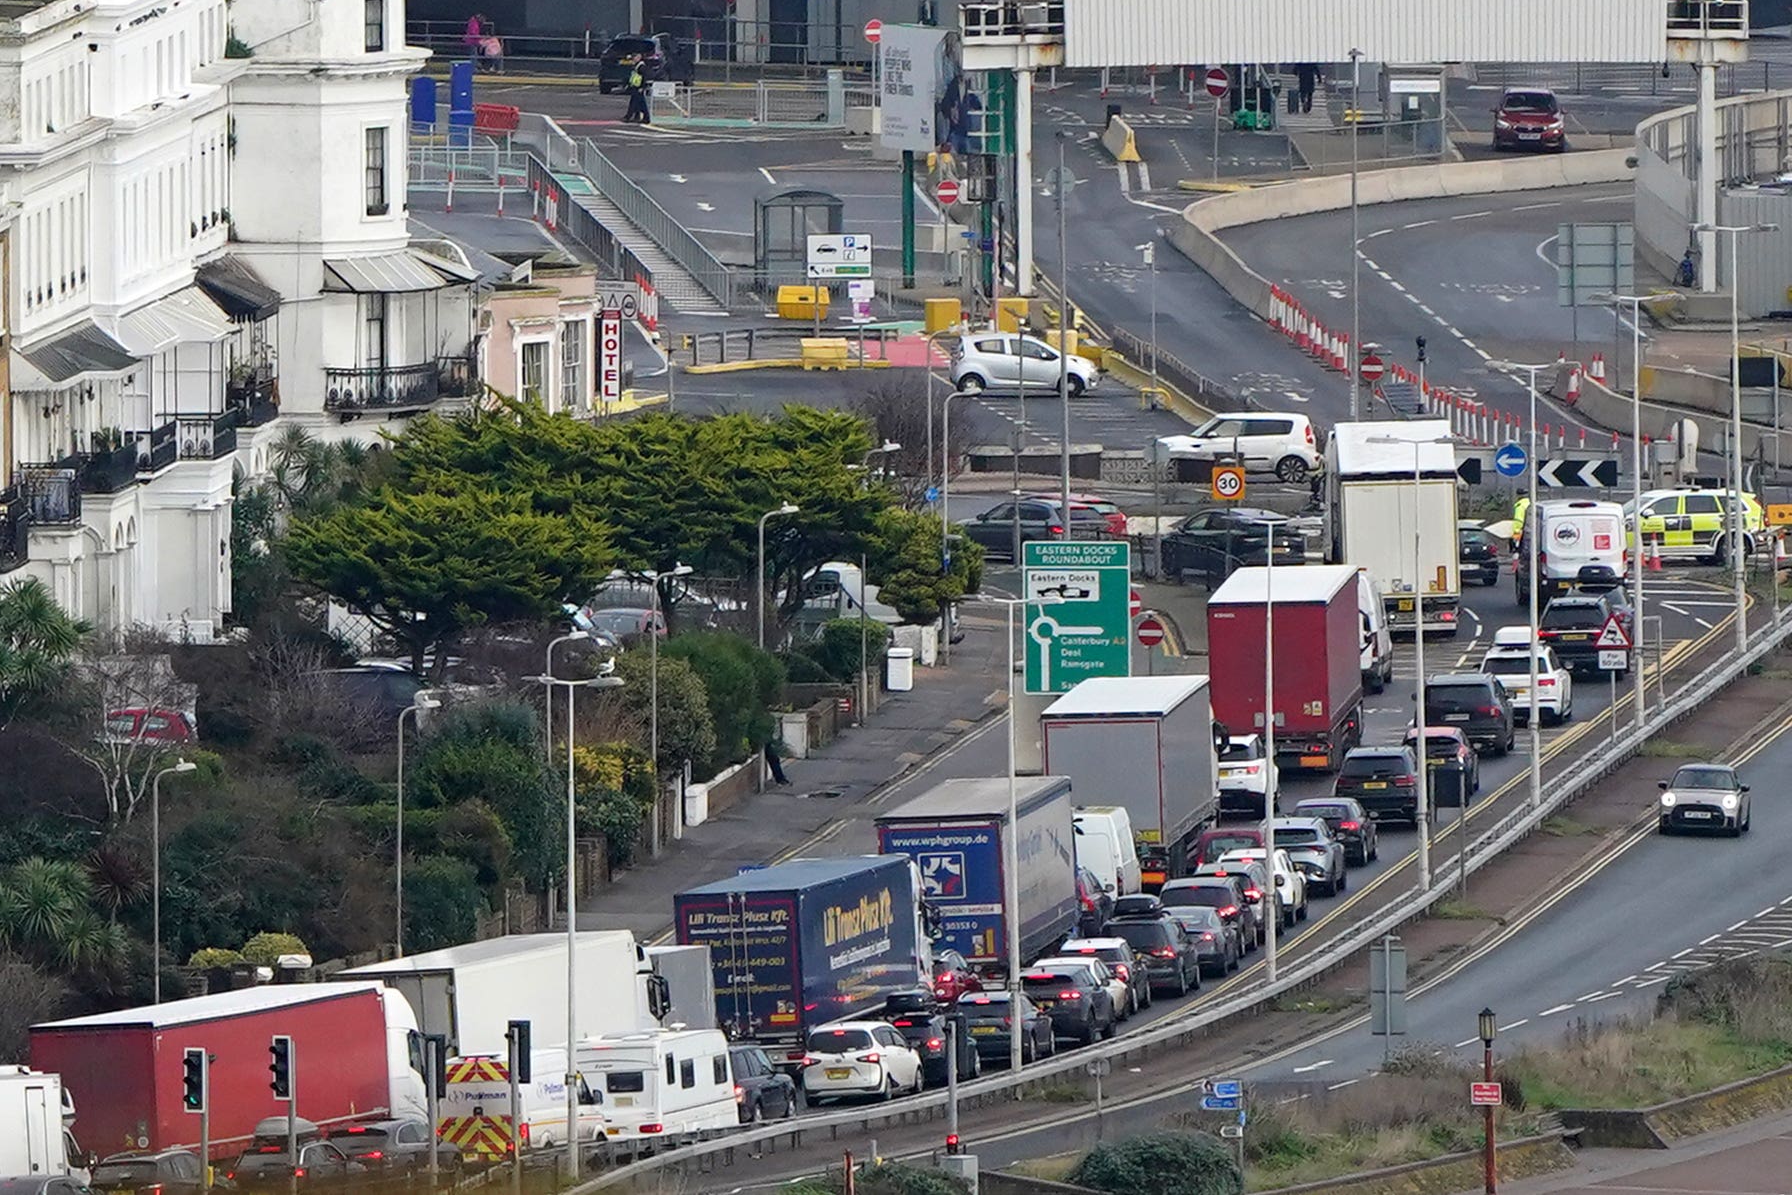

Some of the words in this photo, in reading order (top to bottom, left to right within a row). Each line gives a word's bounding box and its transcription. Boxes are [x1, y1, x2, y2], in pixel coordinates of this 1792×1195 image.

[604, 324, 617, 396] HOTEL
[1219, 477, 1238, 490] 30
[1035, 546, 1080, 555] EASTERN
[1083, 546, 1118, 555] DOCKS
[1042, 555, 1112, 564] ROUNDABOUT
[1031, 574, 1067, 582] Eastern
[1069, 574, 1096, 582] Docks
[1060, 637, 1110, 646] Canterbury
[1060, 660, 1105, 669] Ramsgate
[892, 834, 989, 847] www.wphgroup.de
